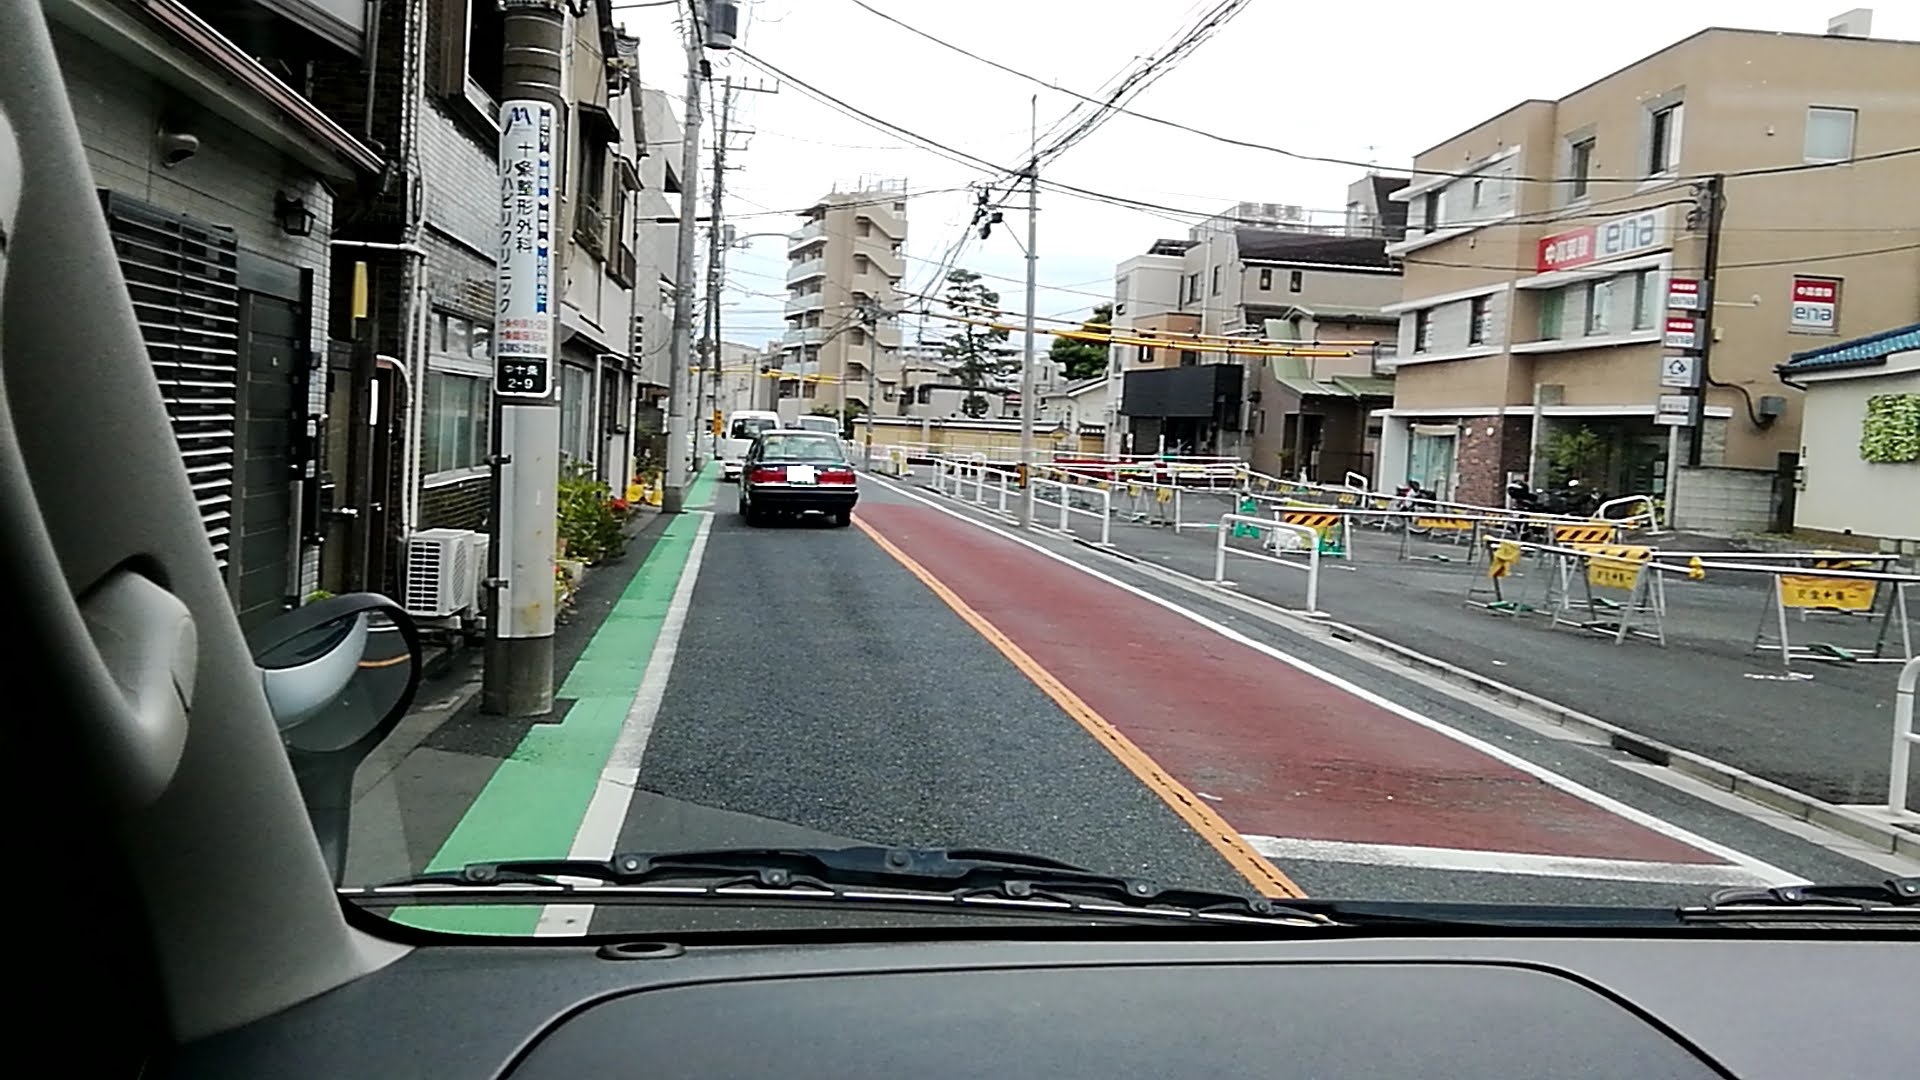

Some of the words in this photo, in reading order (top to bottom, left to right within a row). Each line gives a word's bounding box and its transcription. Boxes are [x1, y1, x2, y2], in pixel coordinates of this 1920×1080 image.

[1605, 213, 1655, 254] ena
[1794, 306, 1832, 321] ena
[507, 378, 534, 389] 2-9
